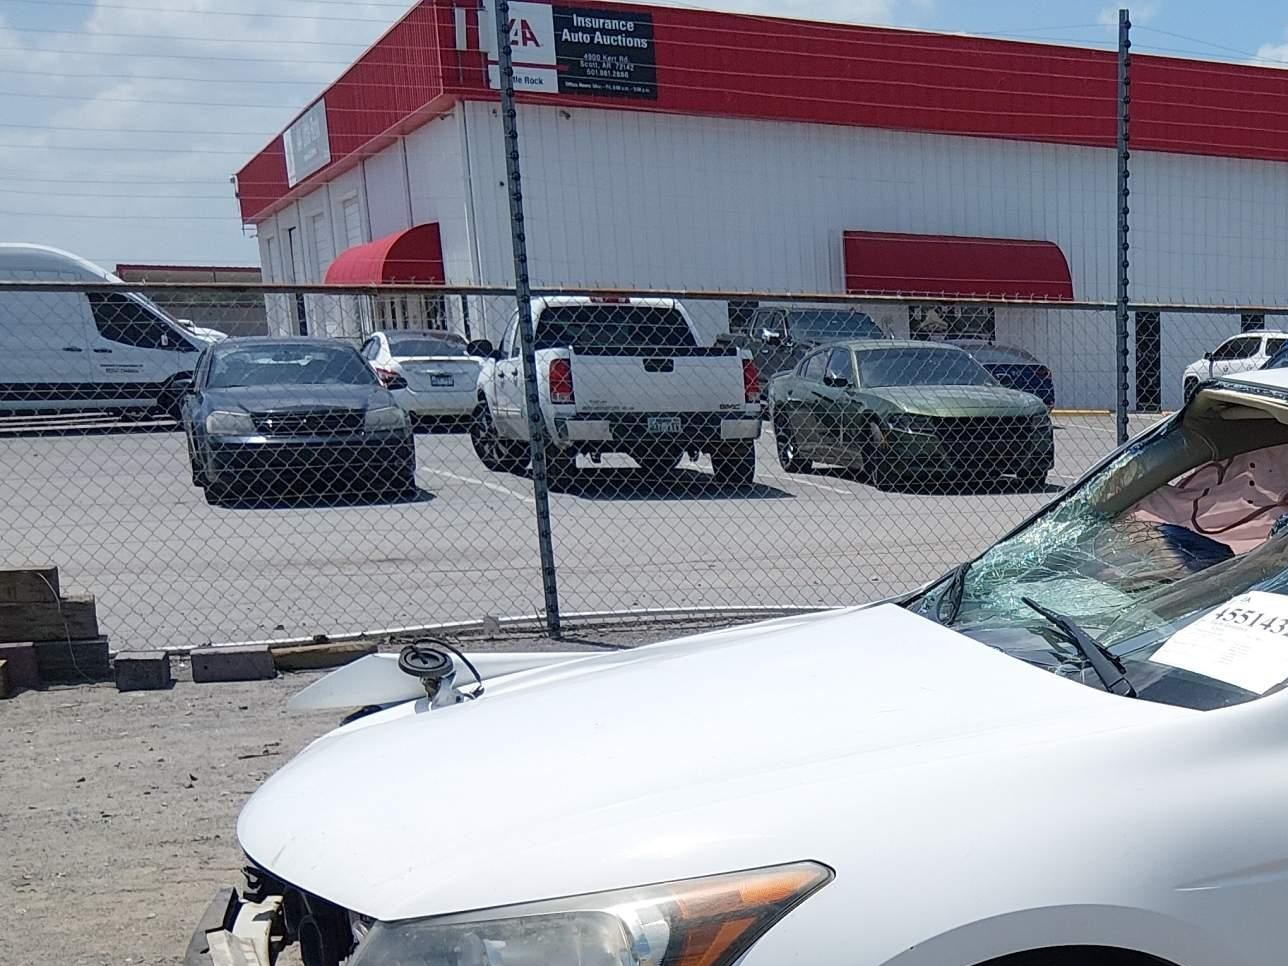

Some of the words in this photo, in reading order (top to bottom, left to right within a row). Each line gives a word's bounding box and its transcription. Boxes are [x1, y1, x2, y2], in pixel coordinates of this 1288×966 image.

[572, 13, 635, 31] Insurance
[561, 28, 591, 44] Auto
[593, 31, 648, 49] Auctions
[524, 76, 544, 86] Rock
